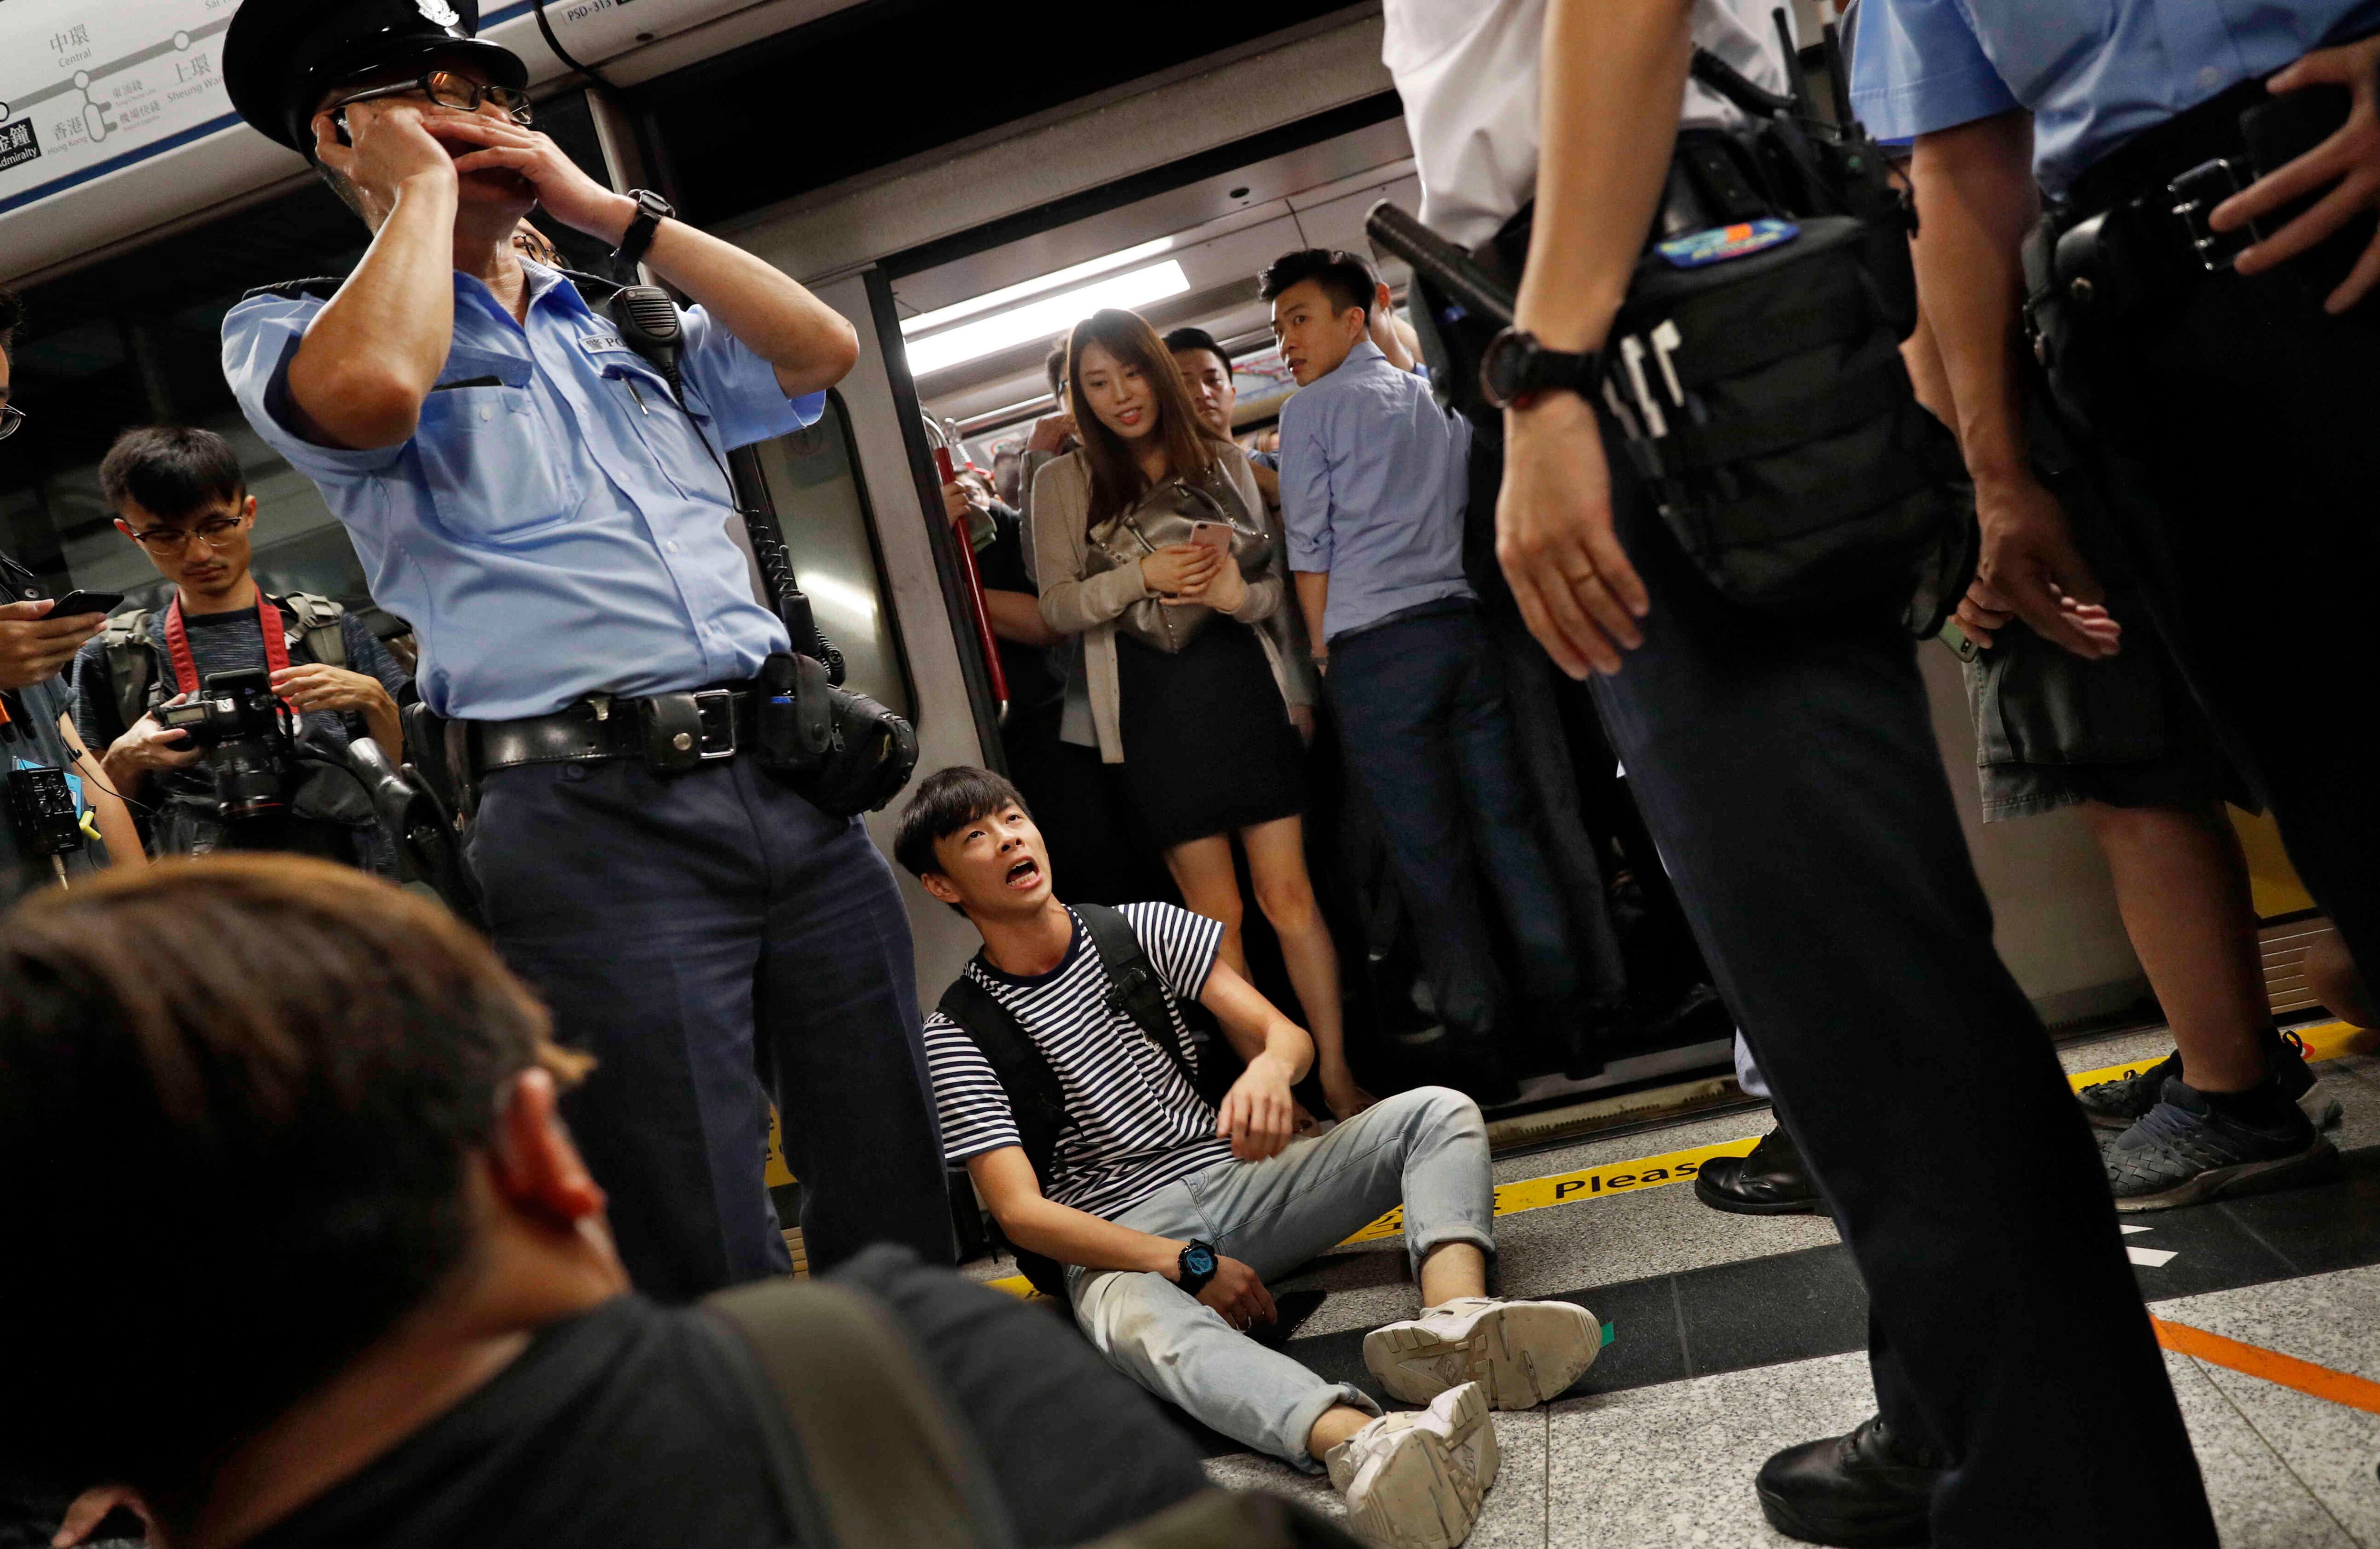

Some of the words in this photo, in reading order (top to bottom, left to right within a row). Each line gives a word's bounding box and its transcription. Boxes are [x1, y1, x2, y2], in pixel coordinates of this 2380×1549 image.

[50, 23, 89, 53] 中環
[59, 48, 91, 68] Central
[174, 53, 211, 85] 上環
[167, 84, 203, 103] Sheung
[52, 116, 83, 140] 香港
[48, 142, 68, 156] Hong
[68, 135, 88, 148] Kong
[0, 147, 37, 168] dmiralty
[1556, 1162, 1698, 1199] Pleas
